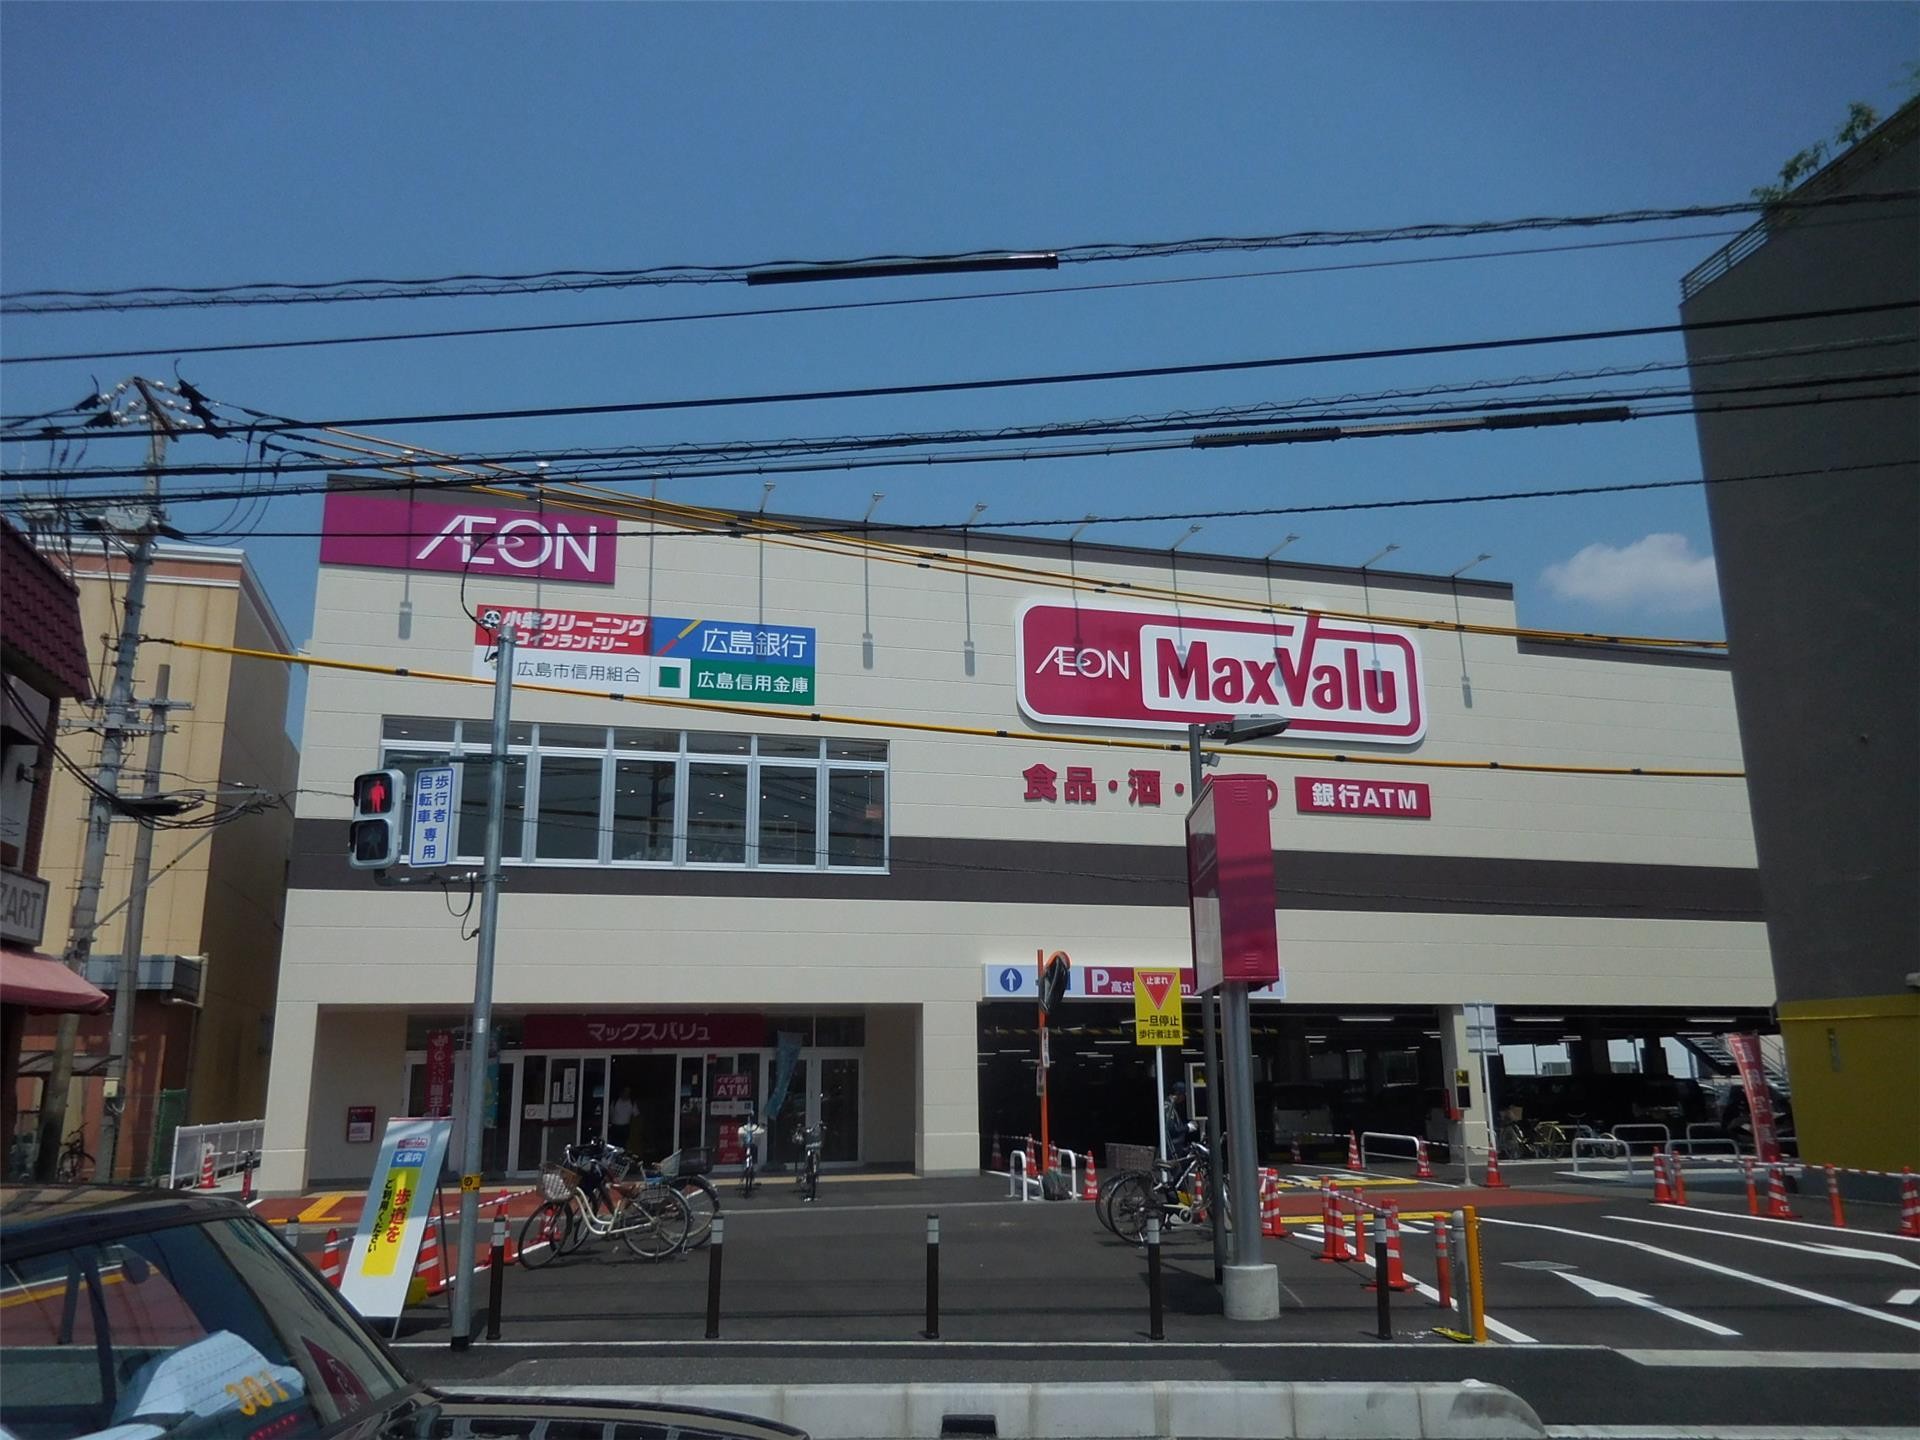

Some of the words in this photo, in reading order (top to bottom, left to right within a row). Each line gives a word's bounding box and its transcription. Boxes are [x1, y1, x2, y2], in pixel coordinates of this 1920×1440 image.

[701, 628, 808, 659] 広島銀行
[516, 660, 642, 683] 広島市信用組合
[1156, 618, 1398, 714] MaxValu
[697, 670, 809, 694] 広島信用金庫
[416, 775, 434, 825] 自転車
[432, 775, 450, 824] 歩行者
[1311, 781, 1418, 810] 銀行ATM
[421, 827, 438, 860] 専用
[1091, 968, 1110, 993] P
[1146, 976, 1169, 985] 止まれ
[586, 1021, 711, 1042] マックスバリュ
[1138, 1014, 1180, 1027] 一旦停止
[717, 1084, 749, 1097] ATM
[386, 1187, 412, 1244] 歩道を
